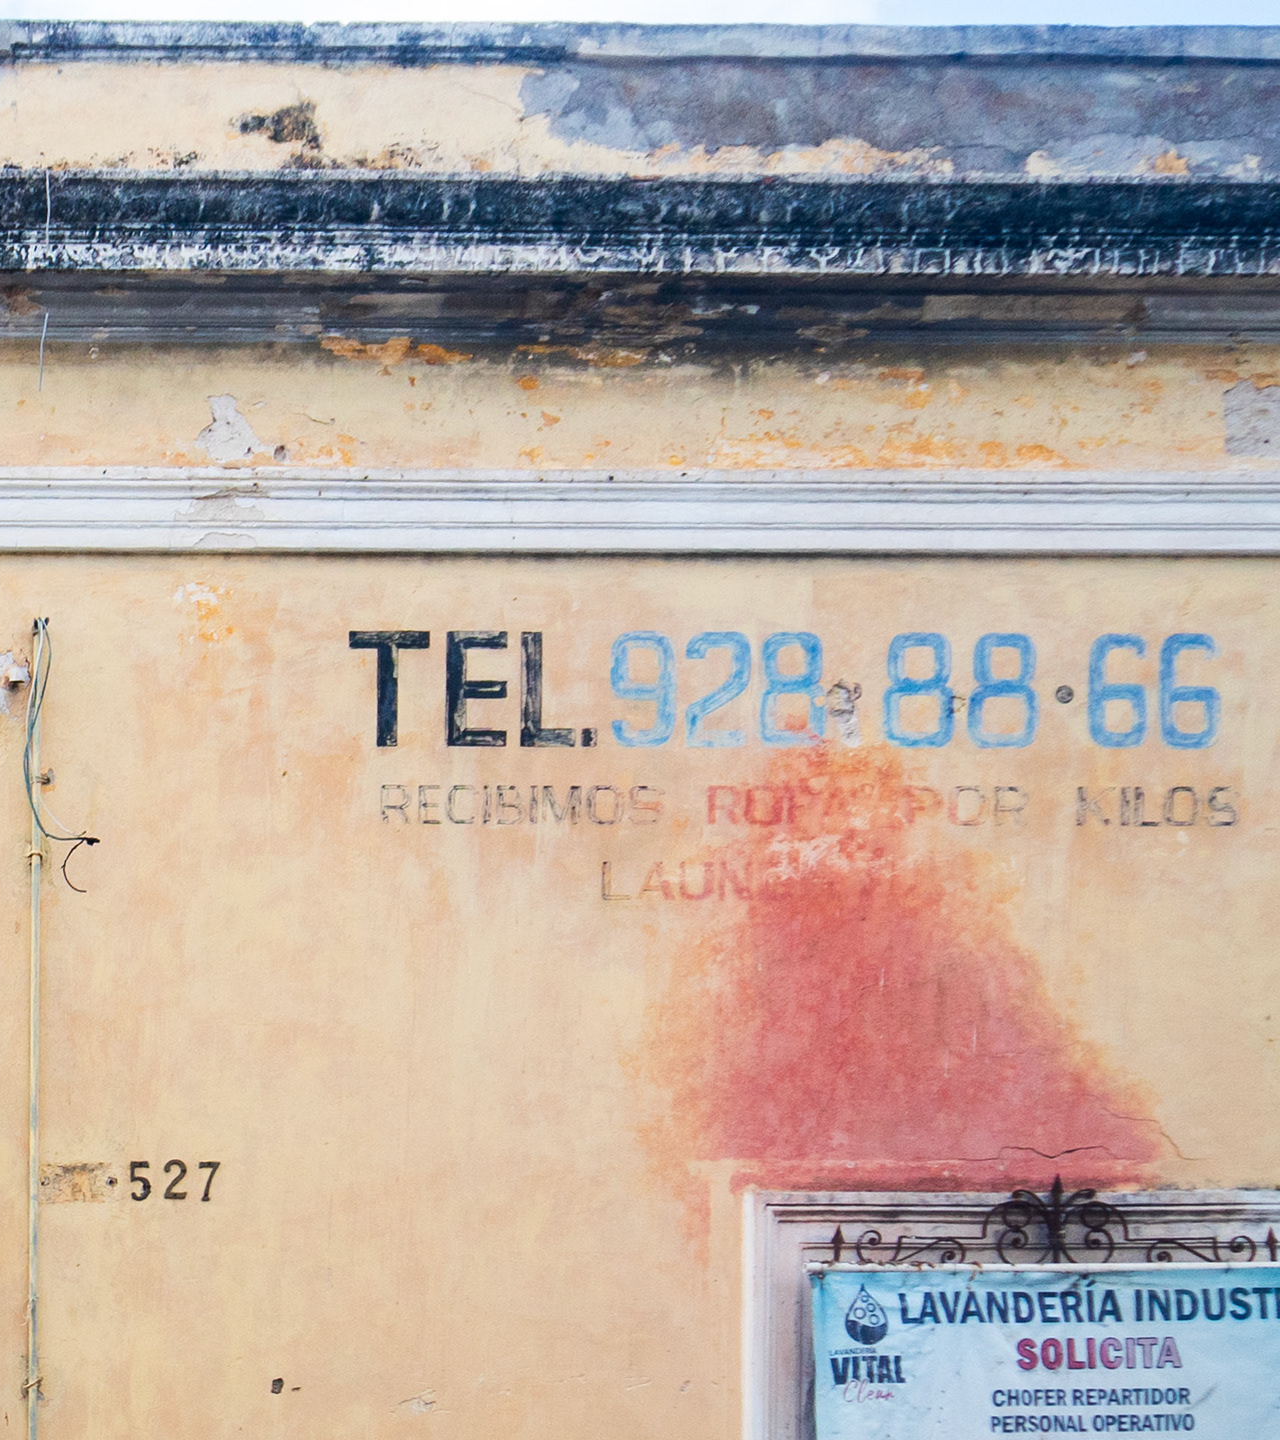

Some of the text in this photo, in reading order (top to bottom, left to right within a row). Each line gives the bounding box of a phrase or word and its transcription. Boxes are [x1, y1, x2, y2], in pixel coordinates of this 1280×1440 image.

[349, 631, 598, 747] TEL.
[380, 784, 666, 825] RECIBIMOS
[706, 785, 849, 826] ROP
[1075, 785, 1239, 828] KILOS
[129, 1158, 221, 1202] 527
[898, 1280, 1280, 1324] LAVANDERÍA INDUST
[830, 1355, 907, 1385] VITAL
[1016, 1337, 1183, 1371] SOLICITA
[992, 1387, 1191, 1408] CHOFER REPARTIDOR
[991, 1413, 1196, 1434] PERSONAL OPERATIVO
